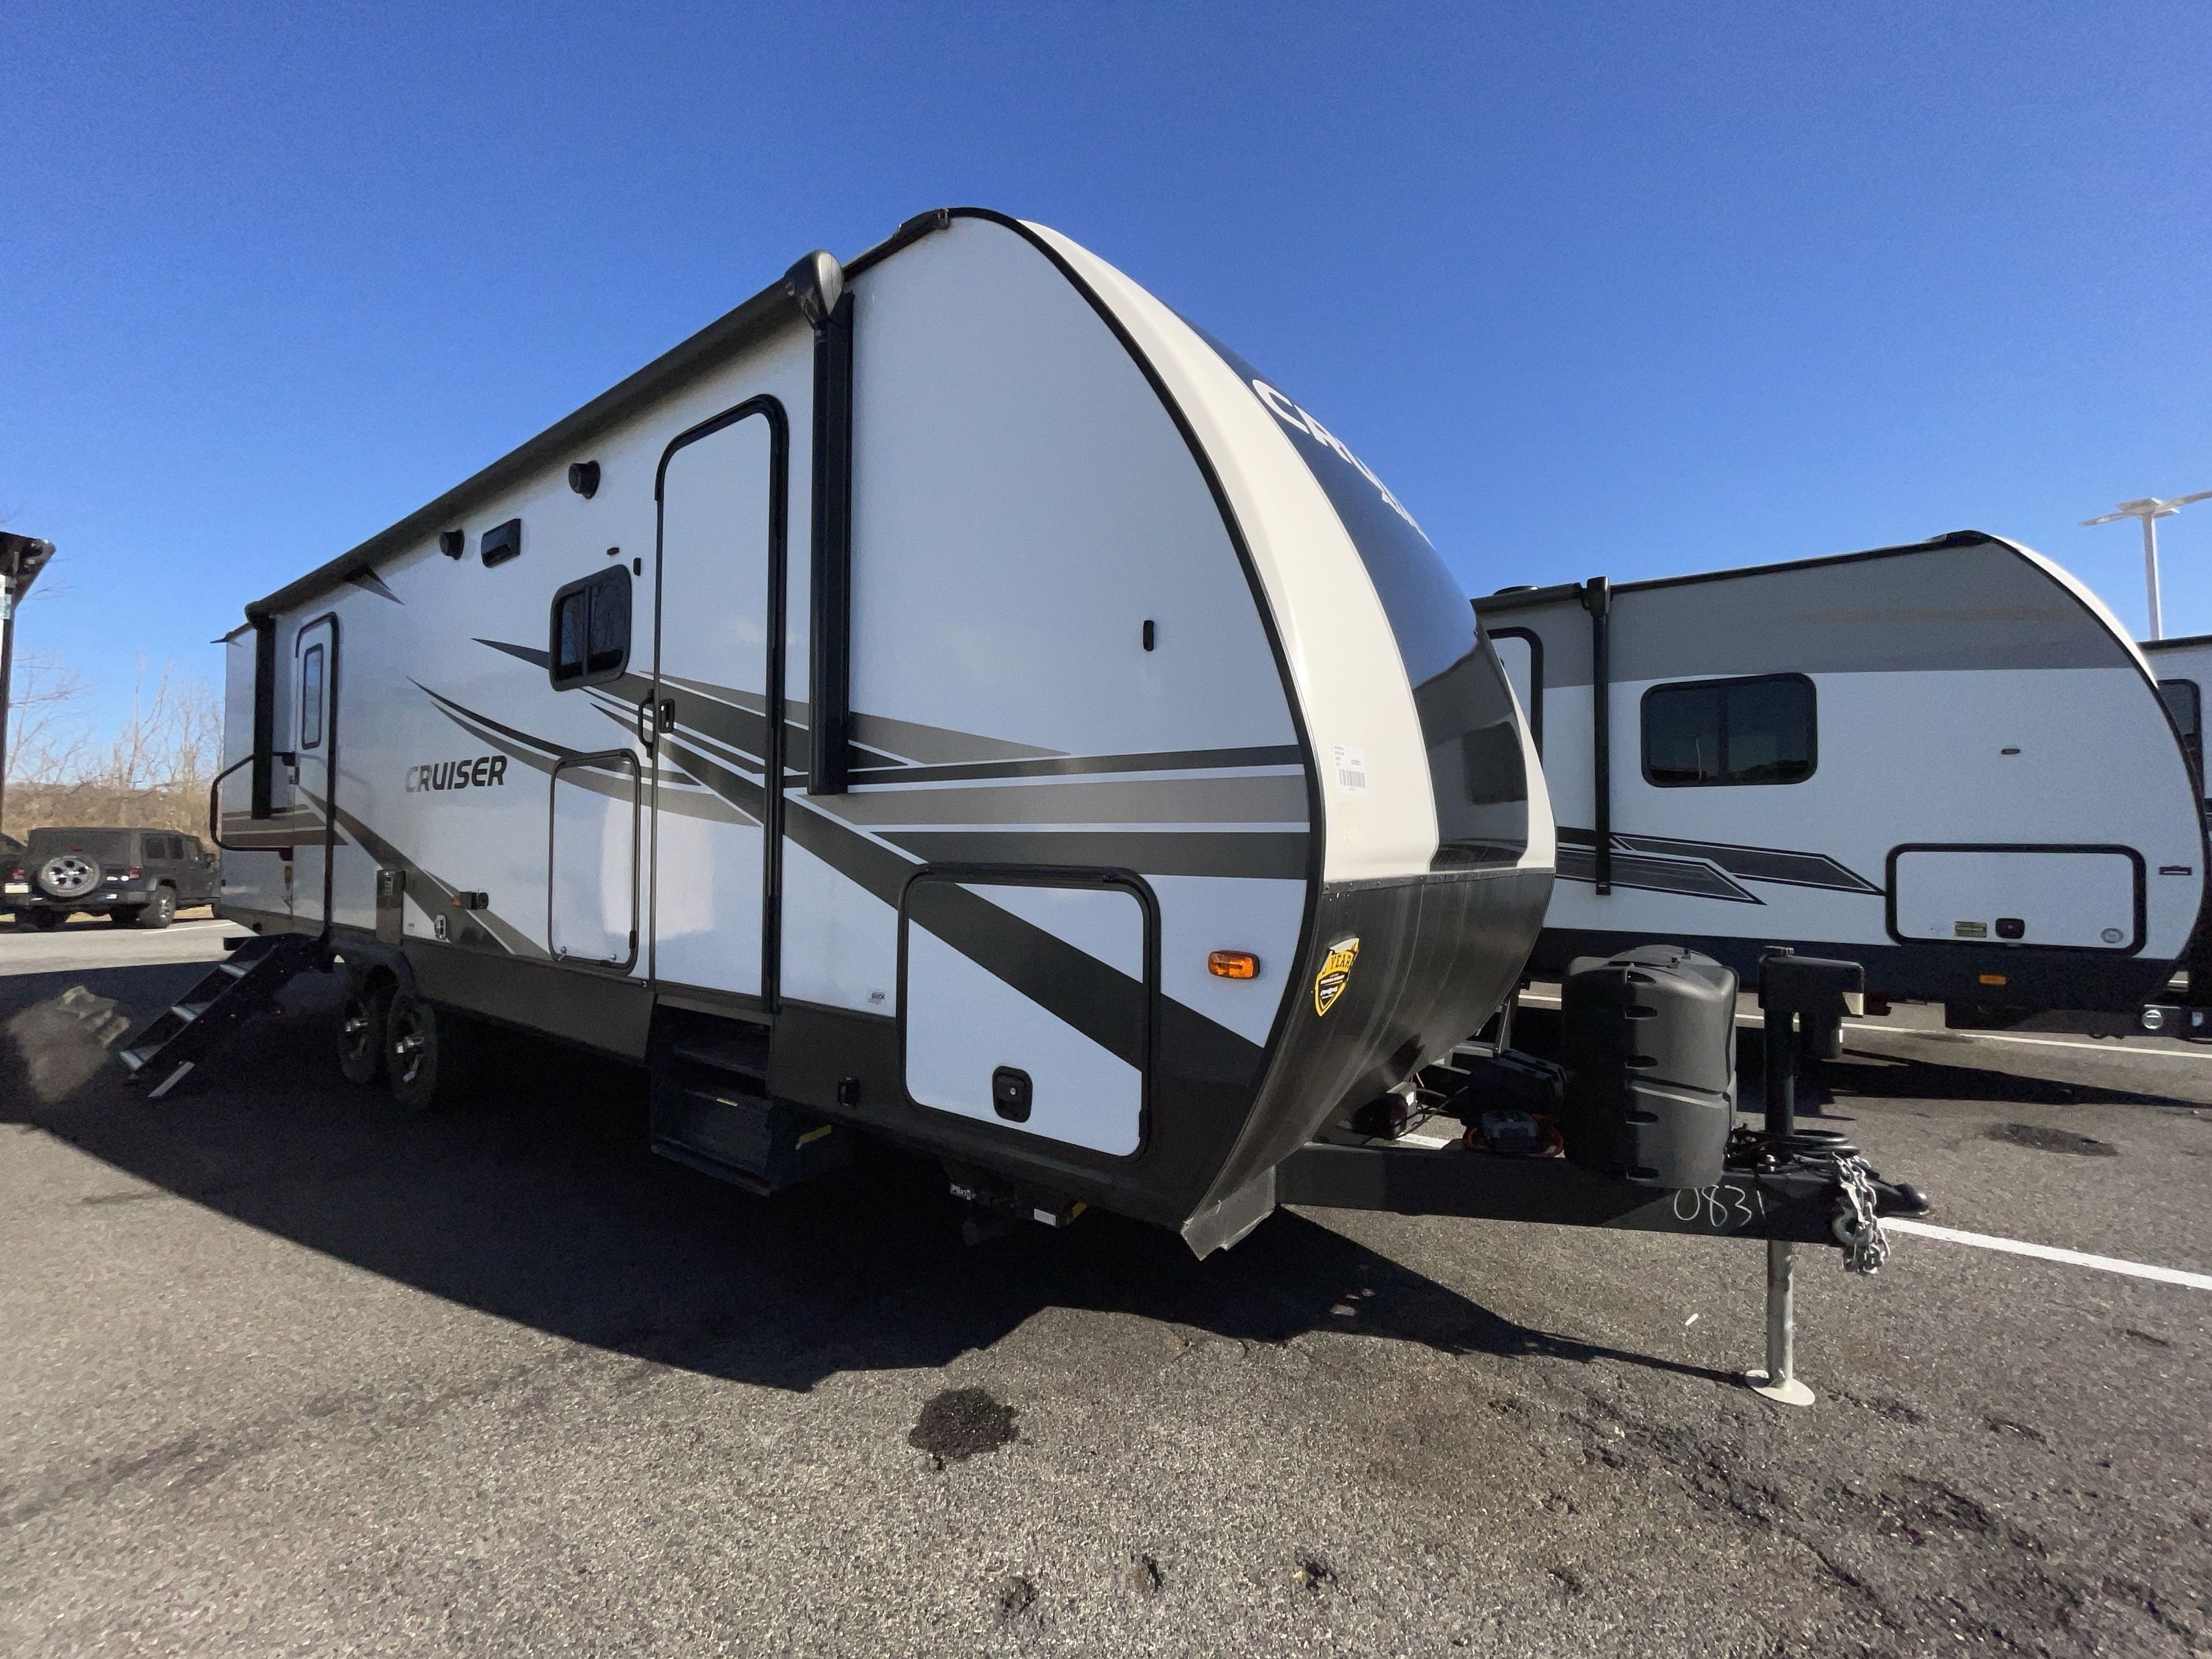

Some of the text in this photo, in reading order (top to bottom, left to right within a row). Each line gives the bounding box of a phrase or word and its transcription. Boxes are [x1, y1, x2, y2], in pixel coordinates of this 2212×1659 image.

[406, 754, 507, 793] CRUISER
[1330, 954, 1352, 970] YEAR
[1674, 1184, 1766, 1227] 0831
